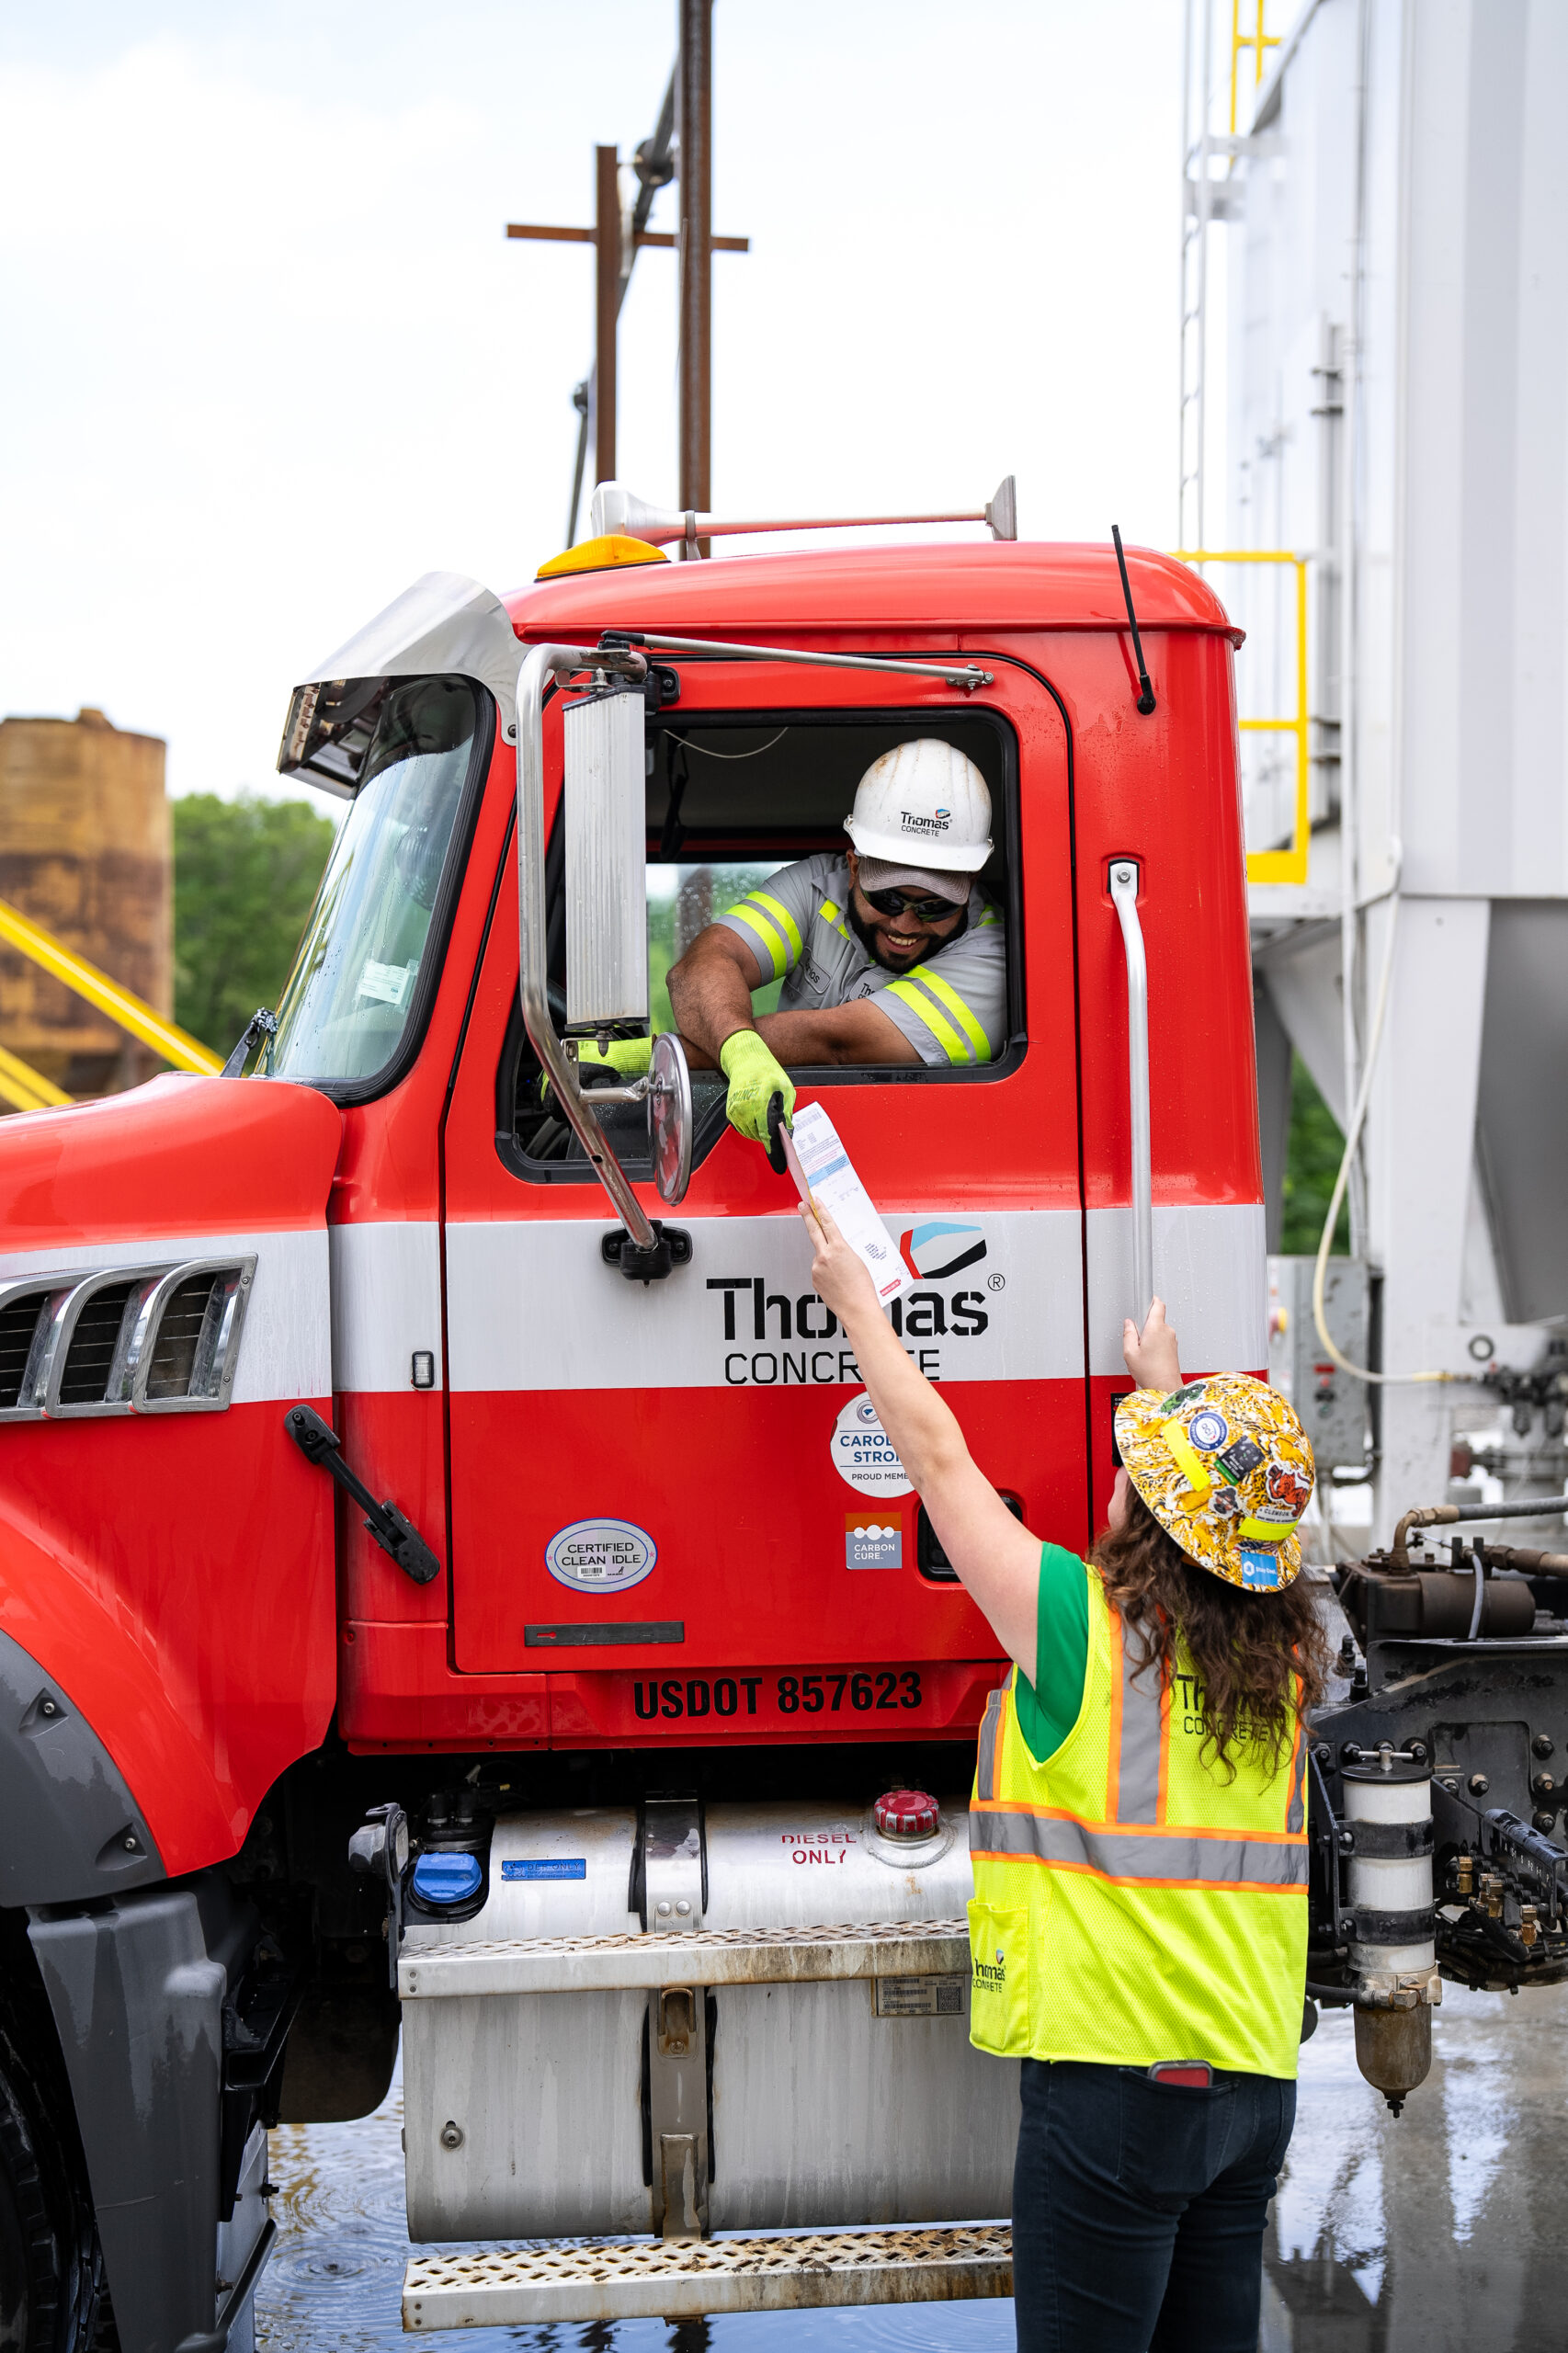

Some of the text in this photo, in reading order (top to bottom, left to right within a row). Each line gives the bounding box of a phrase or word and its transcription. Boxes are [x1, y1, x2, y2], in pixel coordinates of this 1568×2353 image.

[902, 825, 939, 836] CONCRETE
[724, 1348, 940, 1384] CONCRE
[840, 1435, 892, 1448] CAROL
[854, 1451, 900, 1462] STRO
[851, 1472, 882, 1481] PROUD
[567, 1542, 634, 1553] CERTIFIED
[854, 1543, 895, 1552] CARBON
[562, 1554, 641, 1566] CLEAN IDLE
[634, 1671, 923, 1720] USDOT 857623
[781, 1833, 857, 1844] DIESEL
[792, 1849, 846, 1864] ONLY
[552, 1862, 580, 1870] ONLY
